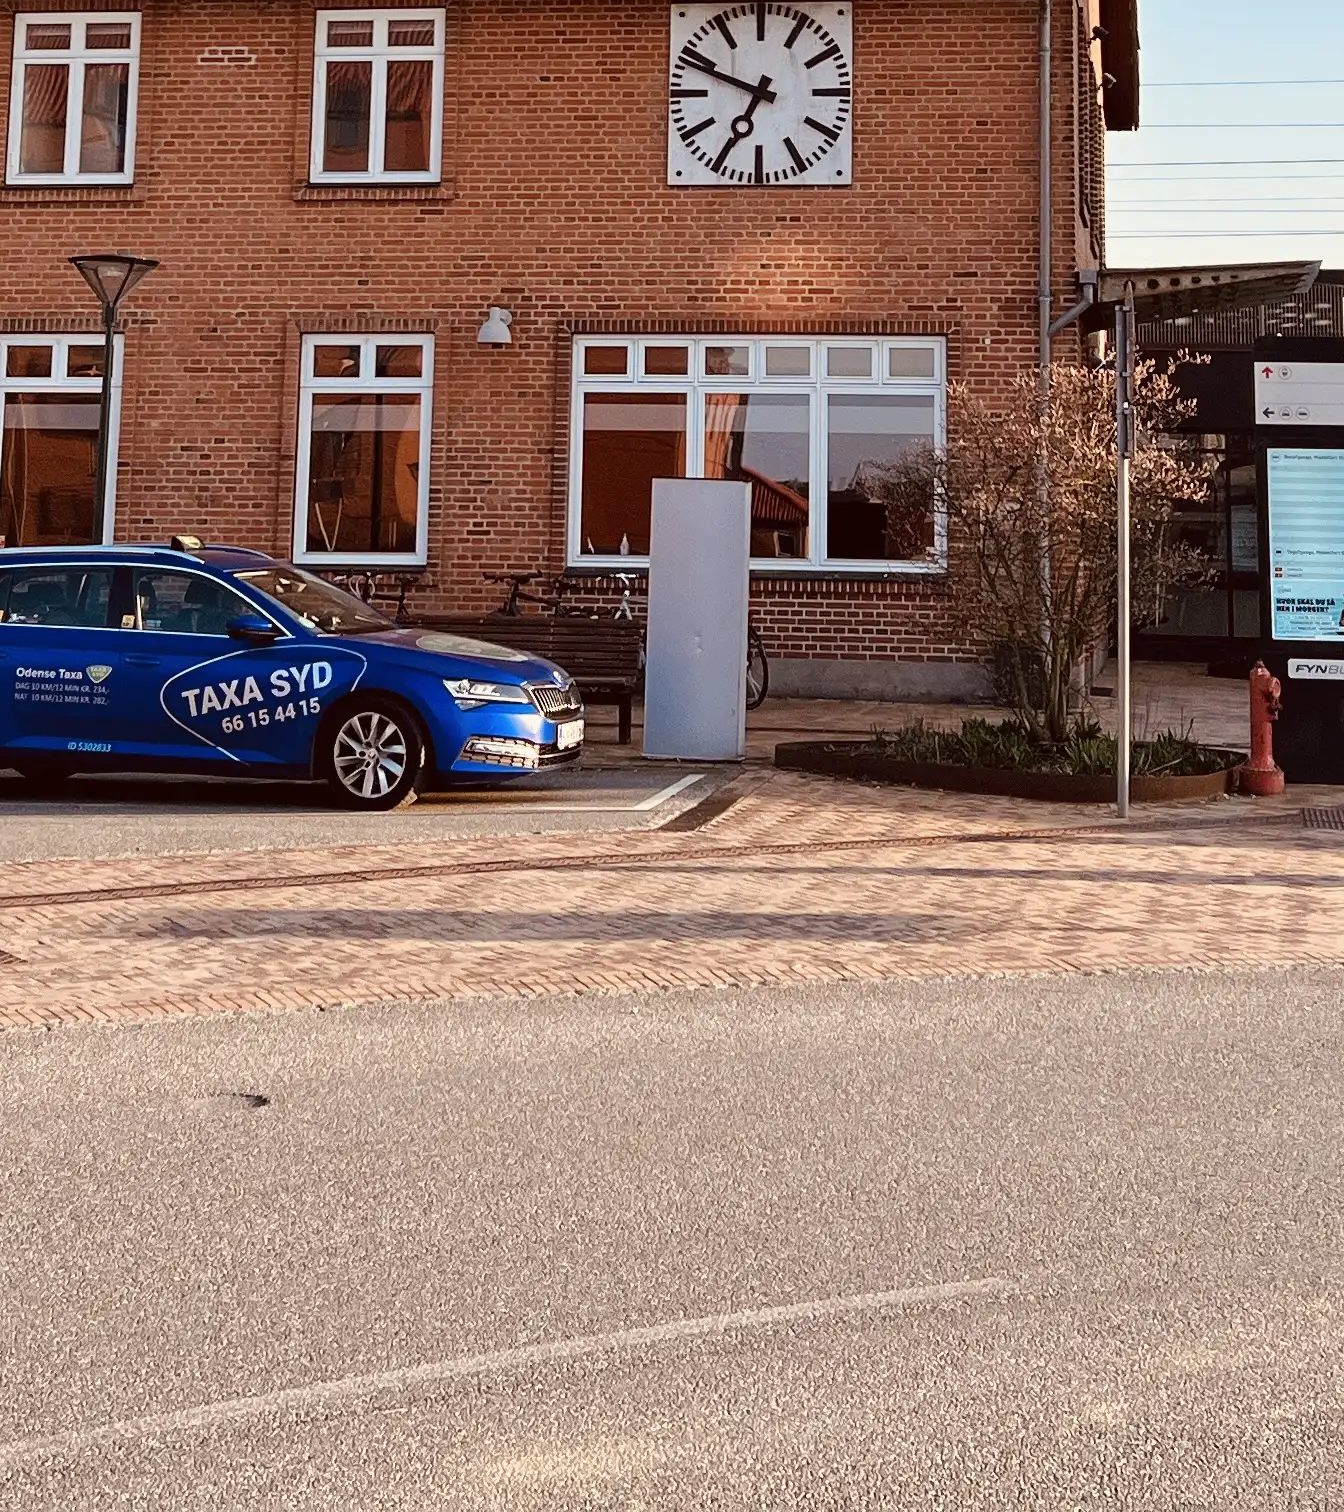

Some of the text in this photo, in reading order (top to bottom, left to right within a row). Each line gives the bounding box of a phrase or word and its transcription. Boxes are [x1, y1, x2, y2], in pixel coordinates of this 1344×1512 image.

[16, 667, 83, 679] Odense Taxa
[181, 661, 333, 717] TAXA SYD
[221, 696, 321, 734] 66 15 44 15
[67, 742, 77, 750] ID
